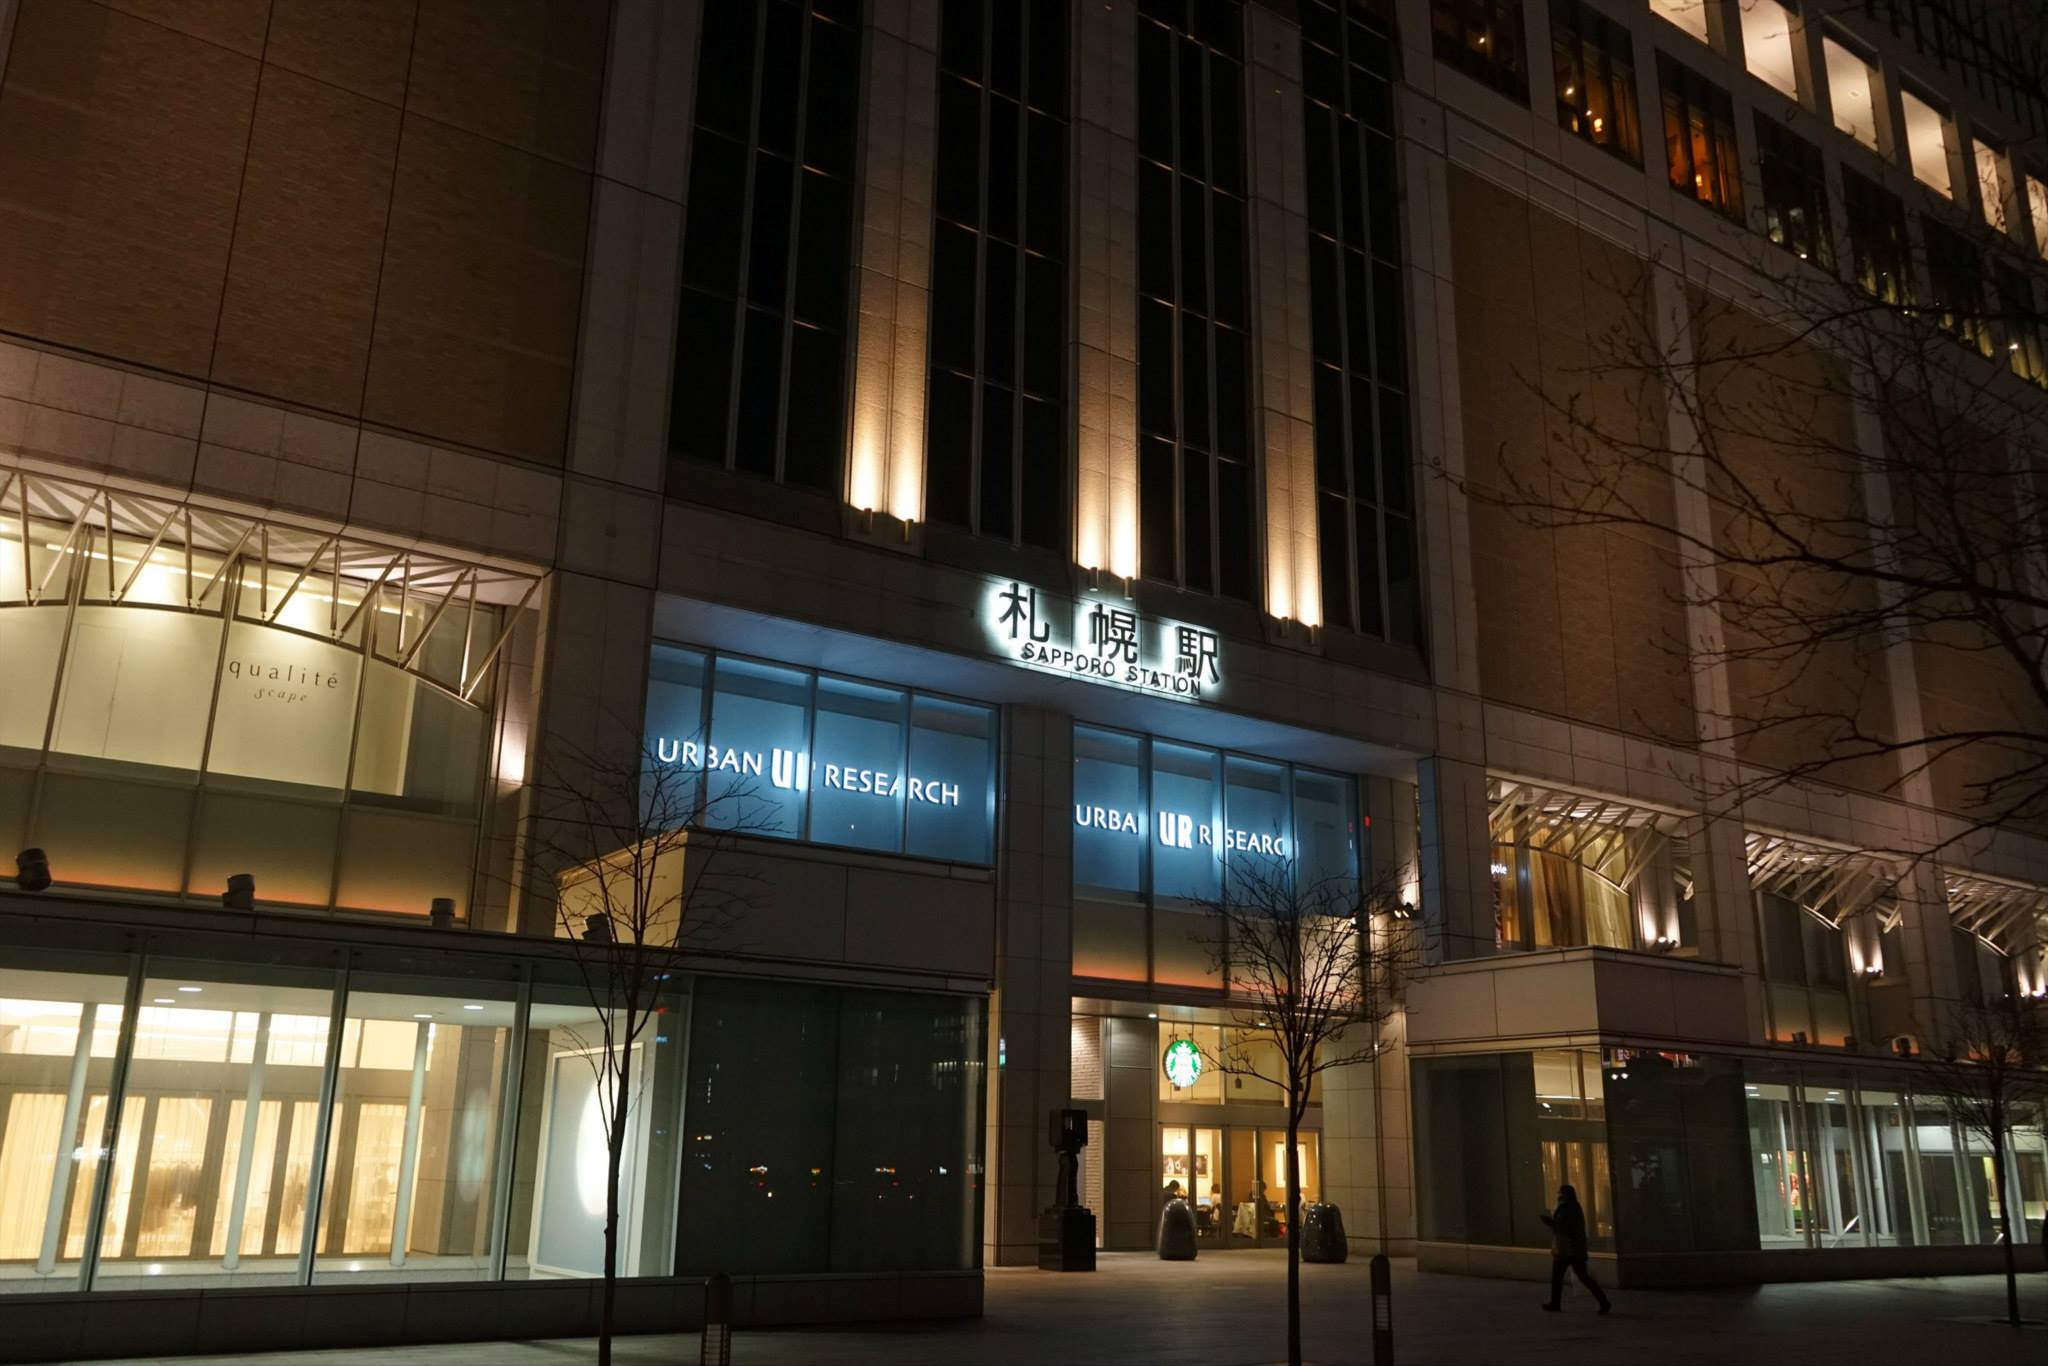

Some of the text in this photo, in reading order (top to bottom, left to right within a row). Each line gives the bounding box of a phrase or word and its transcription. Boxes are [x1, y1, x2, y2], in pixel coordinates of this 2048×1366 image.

[998, 582, 1221, 684] 札幌駅
[229, 660, 338, 689] qualité
[1021, 641, 1201, 696] SAPPORO STATION
[658, 737, 763, 776] URBAN
[824, 763, 960, 806] RESEARCH
[1076, 803, 1299, 857] URBA UR RSEARC
